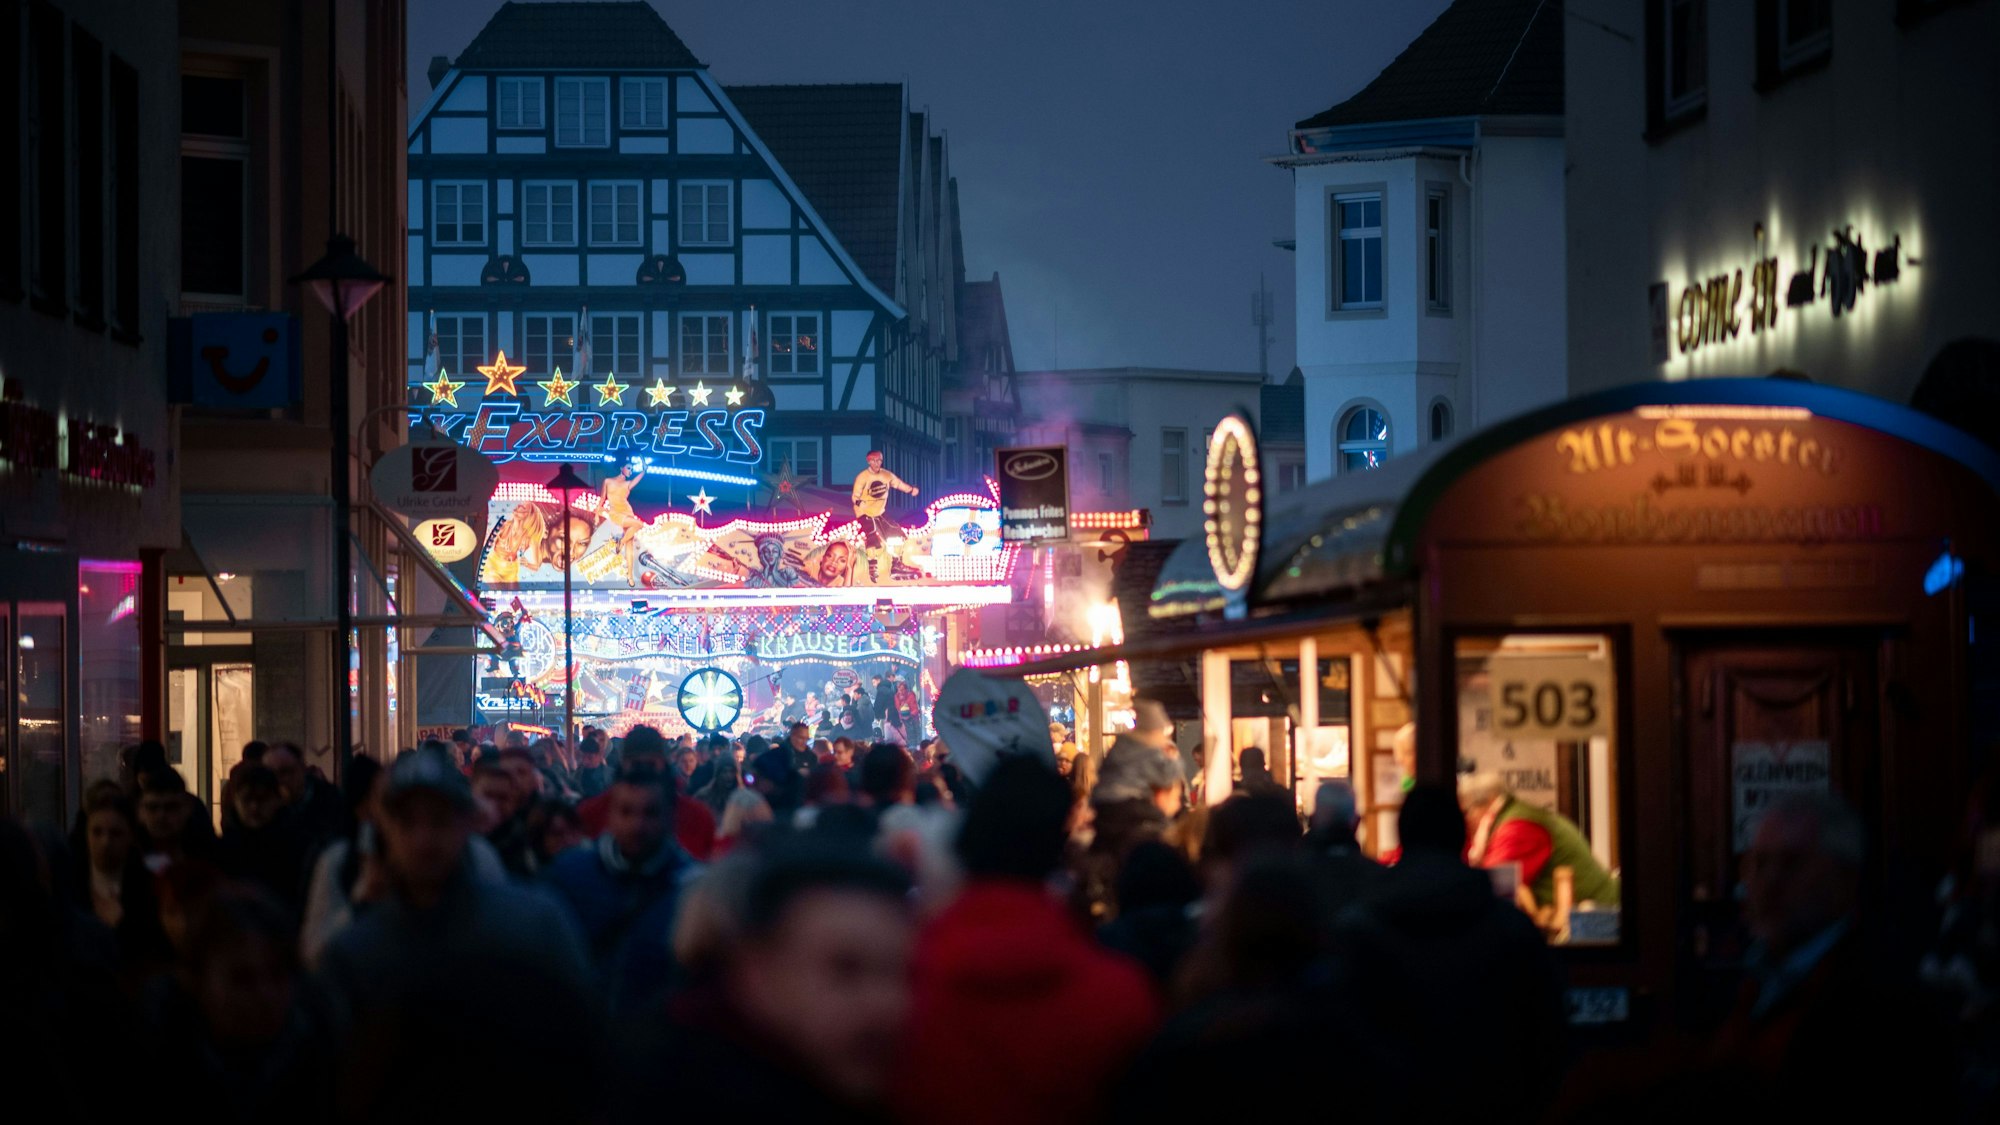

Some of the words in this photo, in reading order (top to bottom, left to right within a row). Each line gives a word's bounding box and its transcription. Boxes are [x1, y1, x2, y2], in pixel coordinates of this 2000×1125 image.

[1679, 268, 1742, 353] come
[1751, 222, 1778, 334] in
[463, 402, 765, 465] EXPRESS
[760, 631, 848, 656] KRAUSE
[1501, 681, 1597, 728] 503
